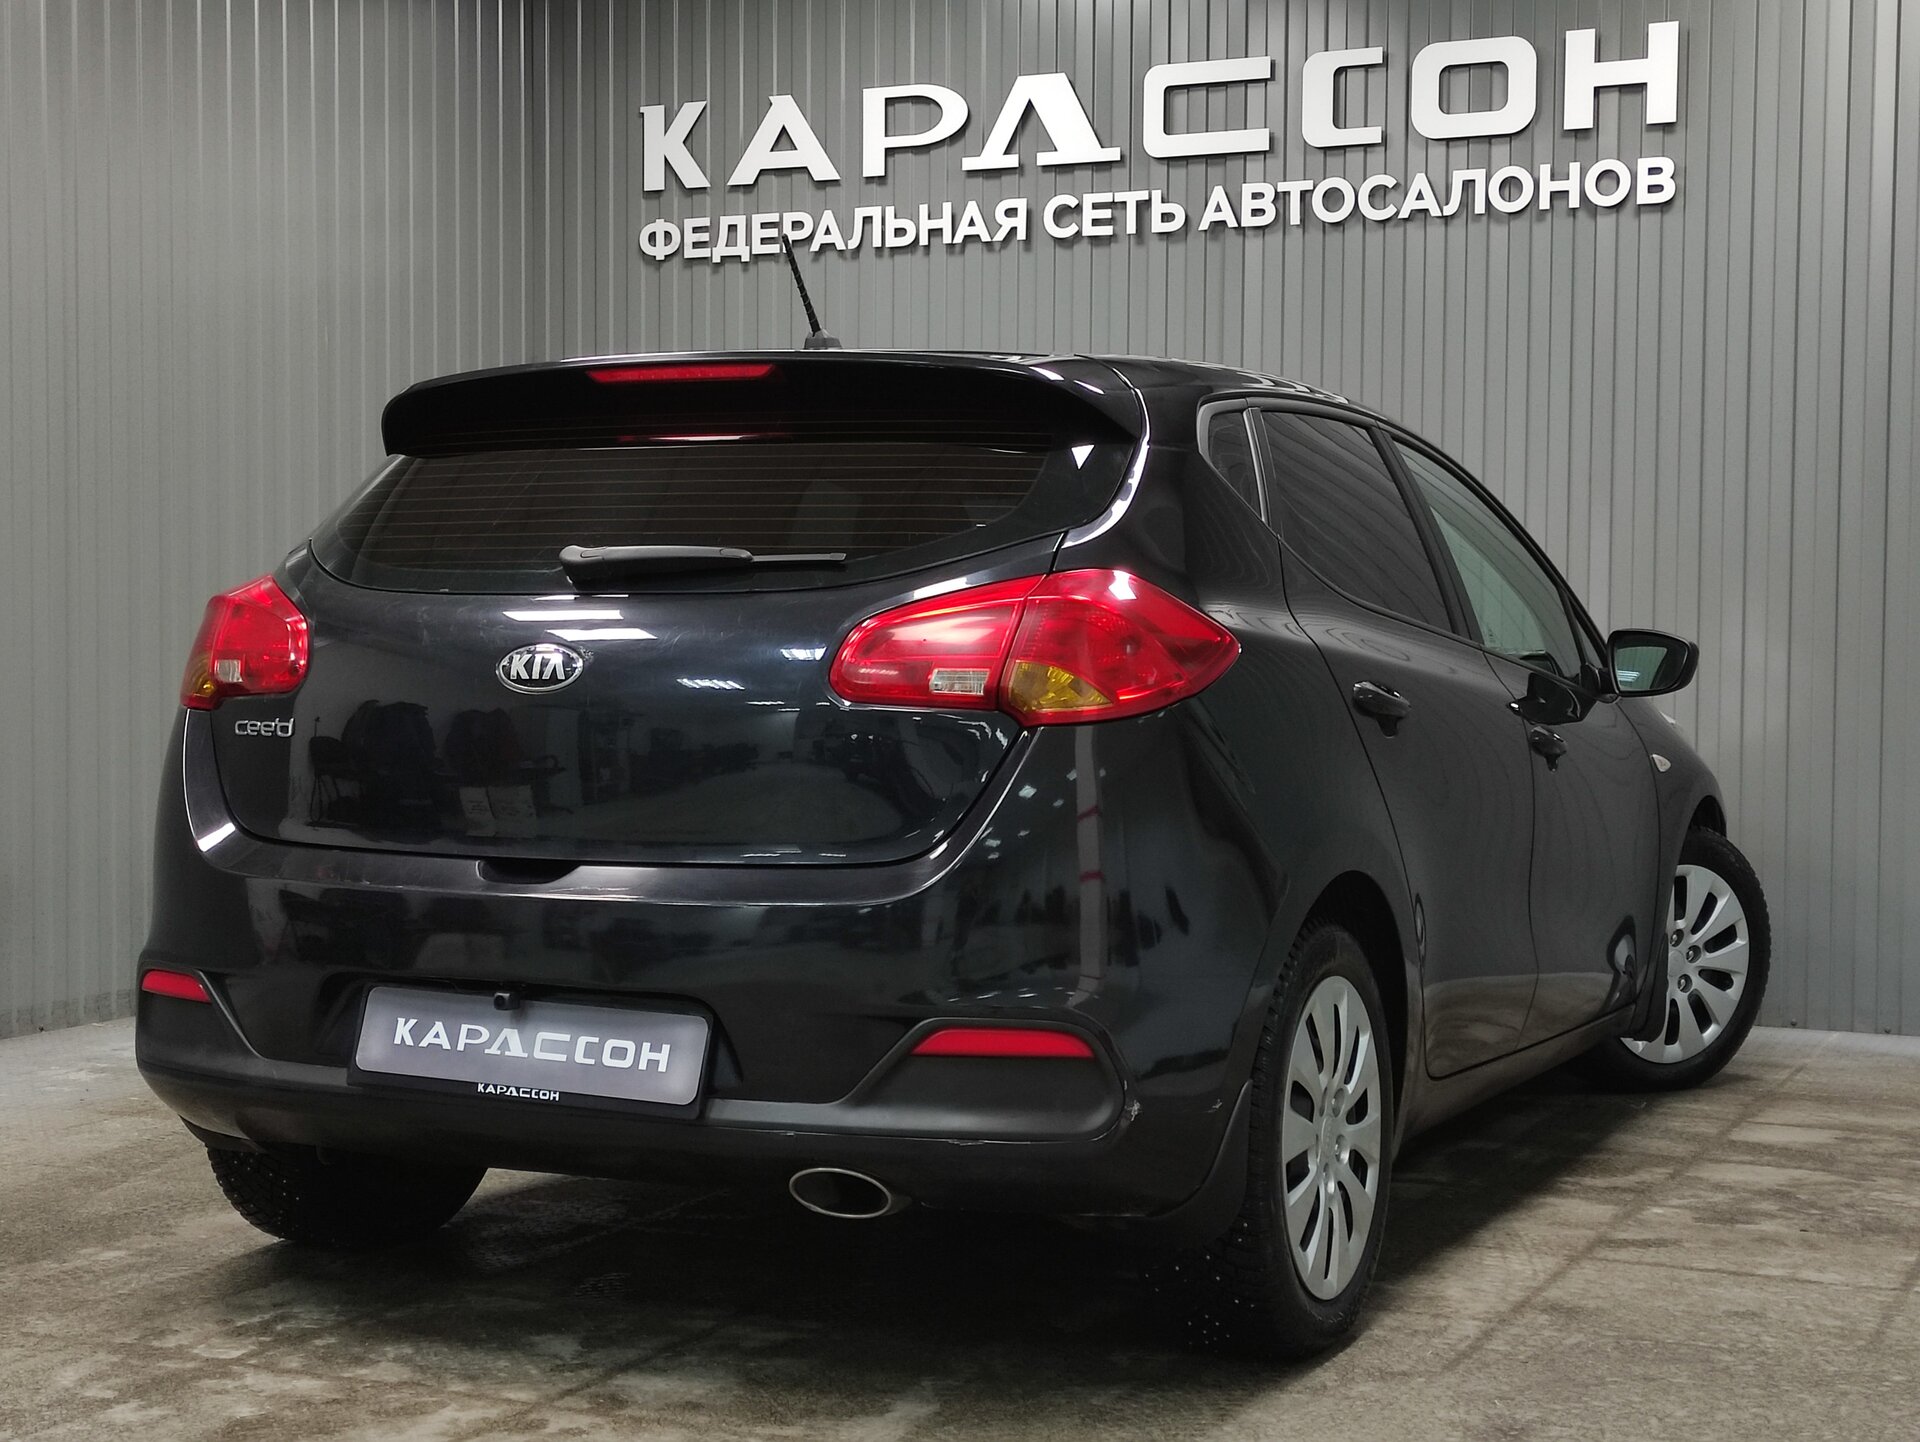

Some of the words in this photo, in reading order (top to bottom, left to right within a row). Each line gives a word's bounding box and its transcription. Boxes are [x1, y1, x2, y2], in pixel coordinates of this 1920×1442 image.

[639, 198, 1028, 263] ФЕДЕРАЛЬНАЯ
[1042, 190, 1186, 239] СЕТЬ
[1198, 156, 1677, 231] АВТОСАЛОНОВ
[509, 652, 567, 681] KIA
[234, 717, 295, 738] cee'd
